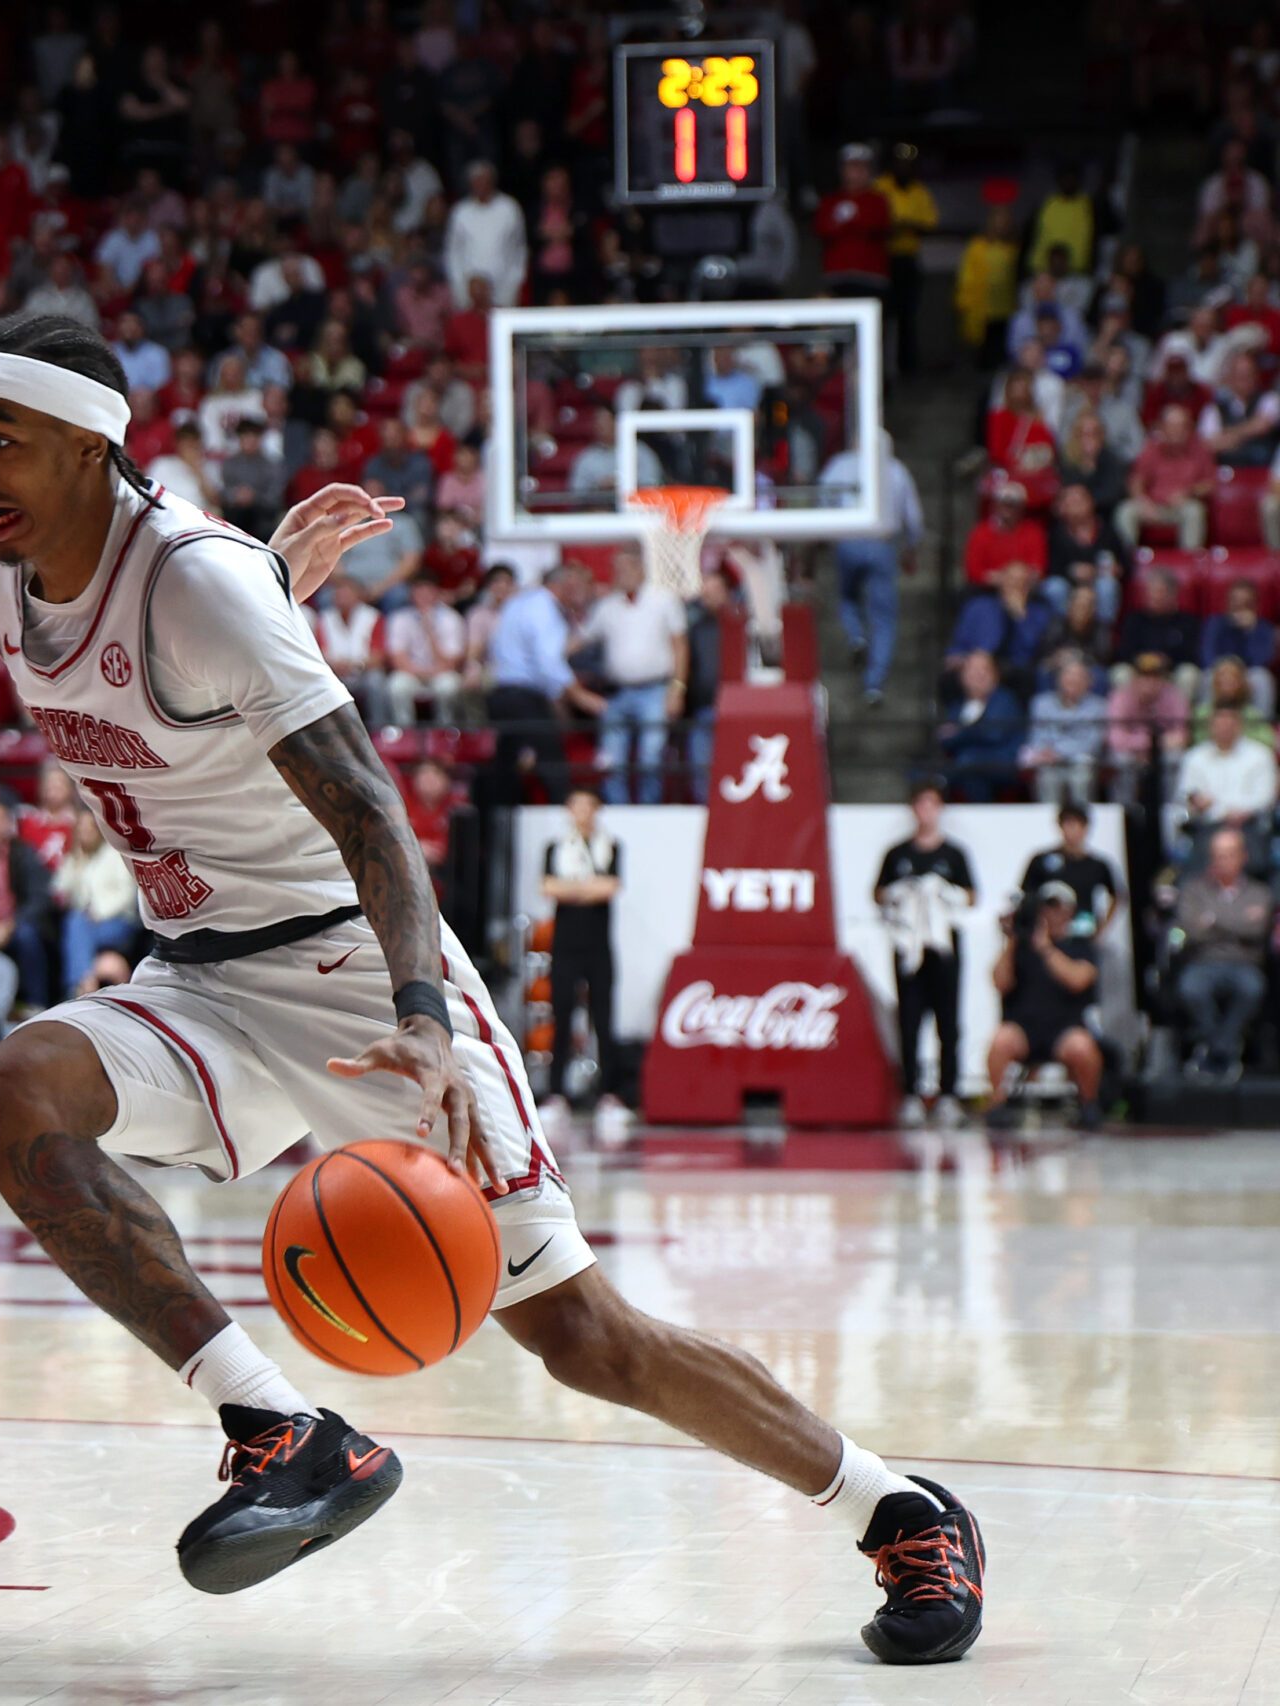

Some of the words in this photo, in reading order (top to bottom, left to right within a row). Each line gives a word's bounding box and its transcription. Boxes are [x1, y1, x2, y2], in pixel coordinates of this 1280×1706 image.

[658, 56, 759, 108] 2:25
[675, 105, 748, 183] 11
[103, 644, 131, 686] SEC
[703, 867, 815, 912] YETI
